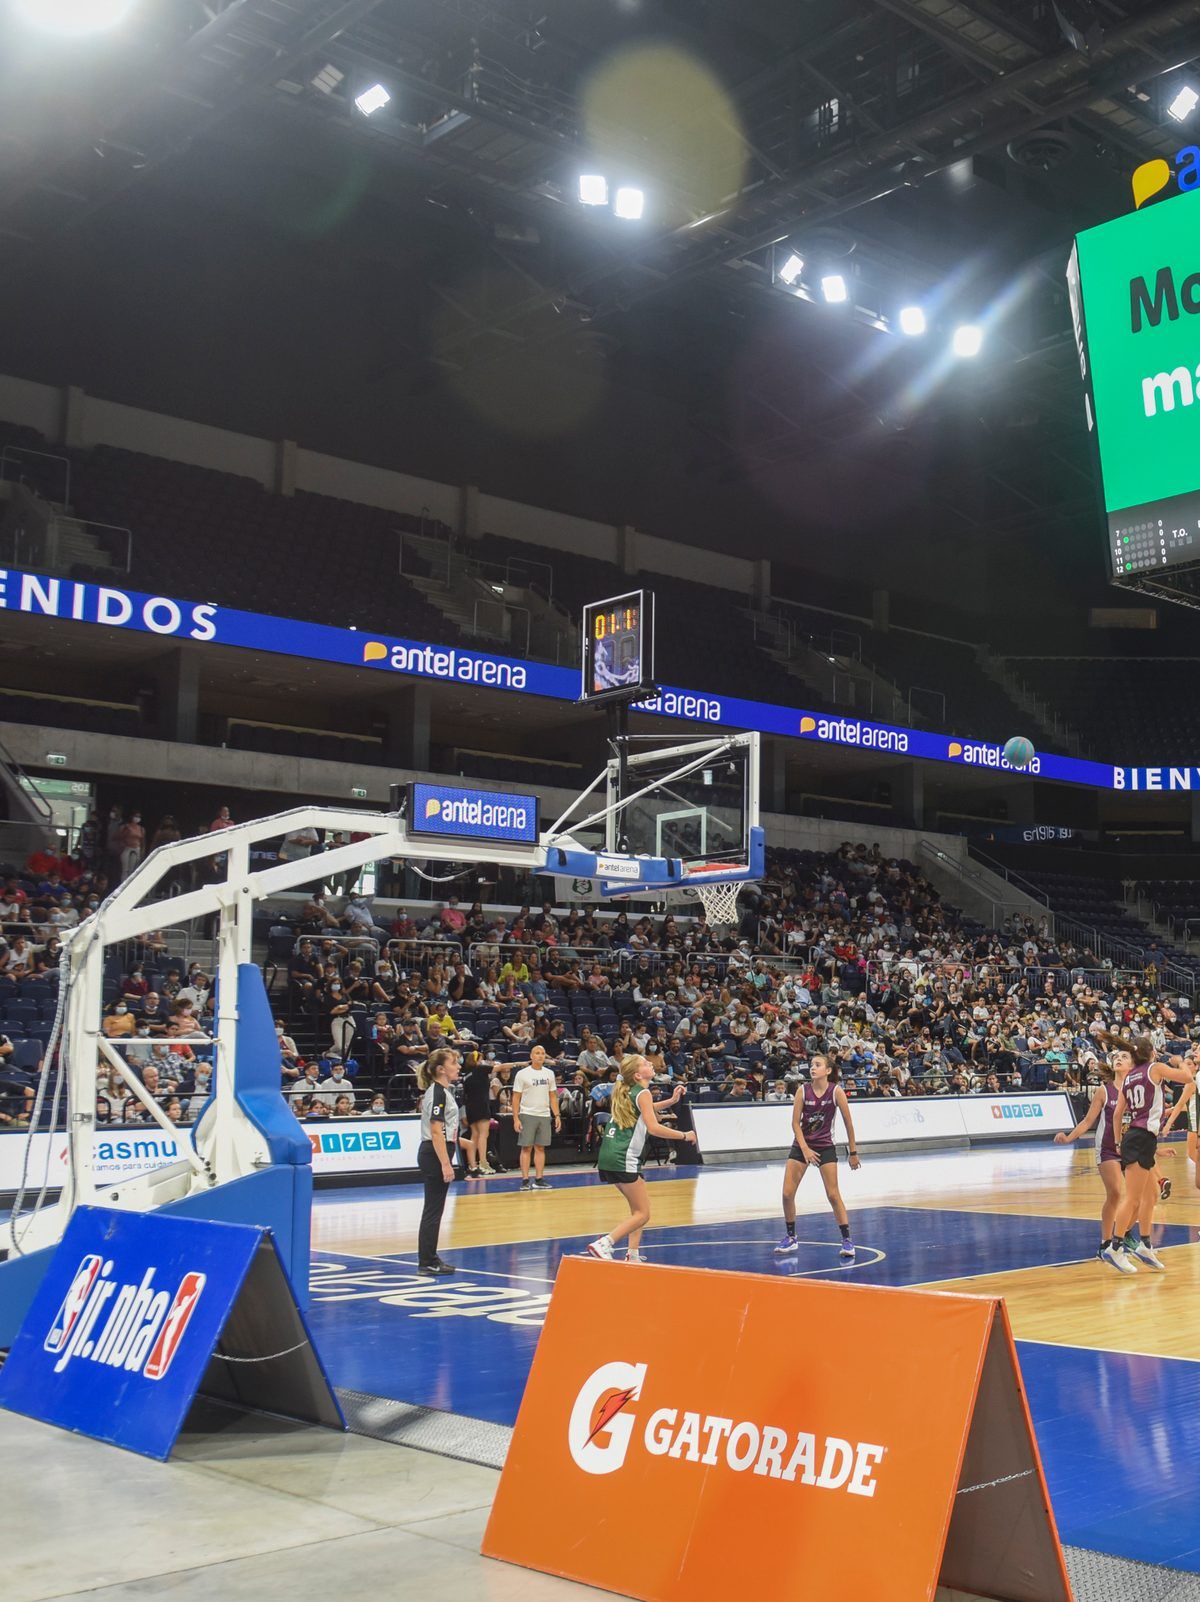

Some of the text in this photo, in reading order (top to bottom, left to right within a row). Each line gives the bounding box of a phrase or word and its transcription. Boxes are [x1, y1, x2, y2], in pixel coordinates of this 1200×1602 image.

[1172, 528, 1188, 538] T.O.
[1114, 538, 1165, 556] 10 0
[1116, 548, 1166, 565] 11 0
[1116, 566, 1124, 574] 12
[0, 570, 217, 641] NIDOS
[391, 645, 526, 689] antel arena
[664, 693, 721, 721] arena
[818, 719, 908, 752] antel arena
[963, 744, 999, 767] antel
[443, 798, 526, 829] antel arena
[604, 863, 638, 874] antel arena
[1126, 1085, 1145, 1110] 10
[1003, 1105, 1042, 1117] 1727
[92, 1140, 177, 1159] asmu
[323, 1132, 399, 1151] 1727
[92, 1163, 120, 1171] amos
[122, 1162, 142, 1171] para
[54, 1260, 170, 1372] jr.nba
[644, 1407, 886, 1497] GATORADE
